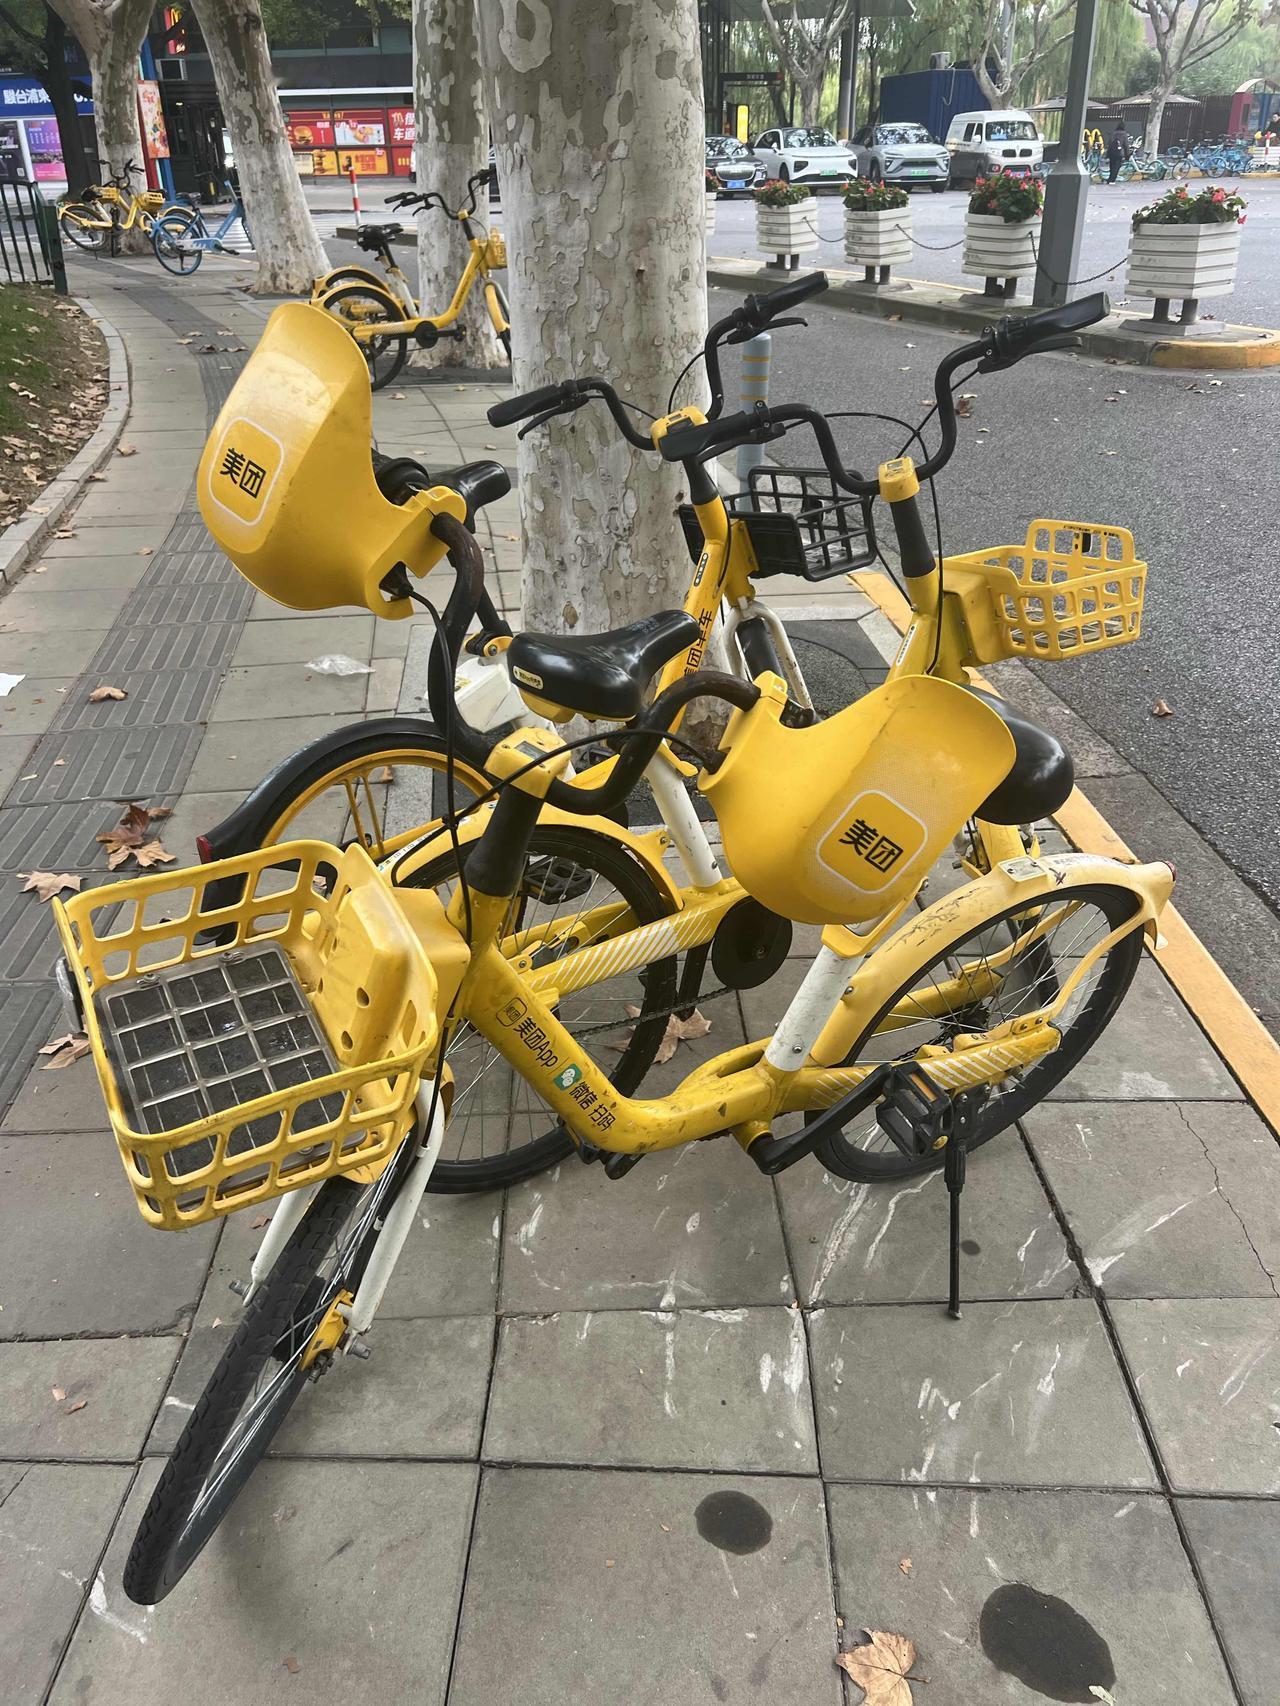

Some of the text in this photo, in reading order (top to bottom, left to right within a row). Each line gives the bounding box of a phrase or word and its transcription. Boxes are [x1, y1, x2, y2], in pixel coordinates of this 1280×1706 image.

[219, 448, 266, 499] 美团
[838, 818, 904, 873] 美团
[513, 1016, 559, 1068] 美团App
[568, 1081, 616, 1132] 微信 扫码
